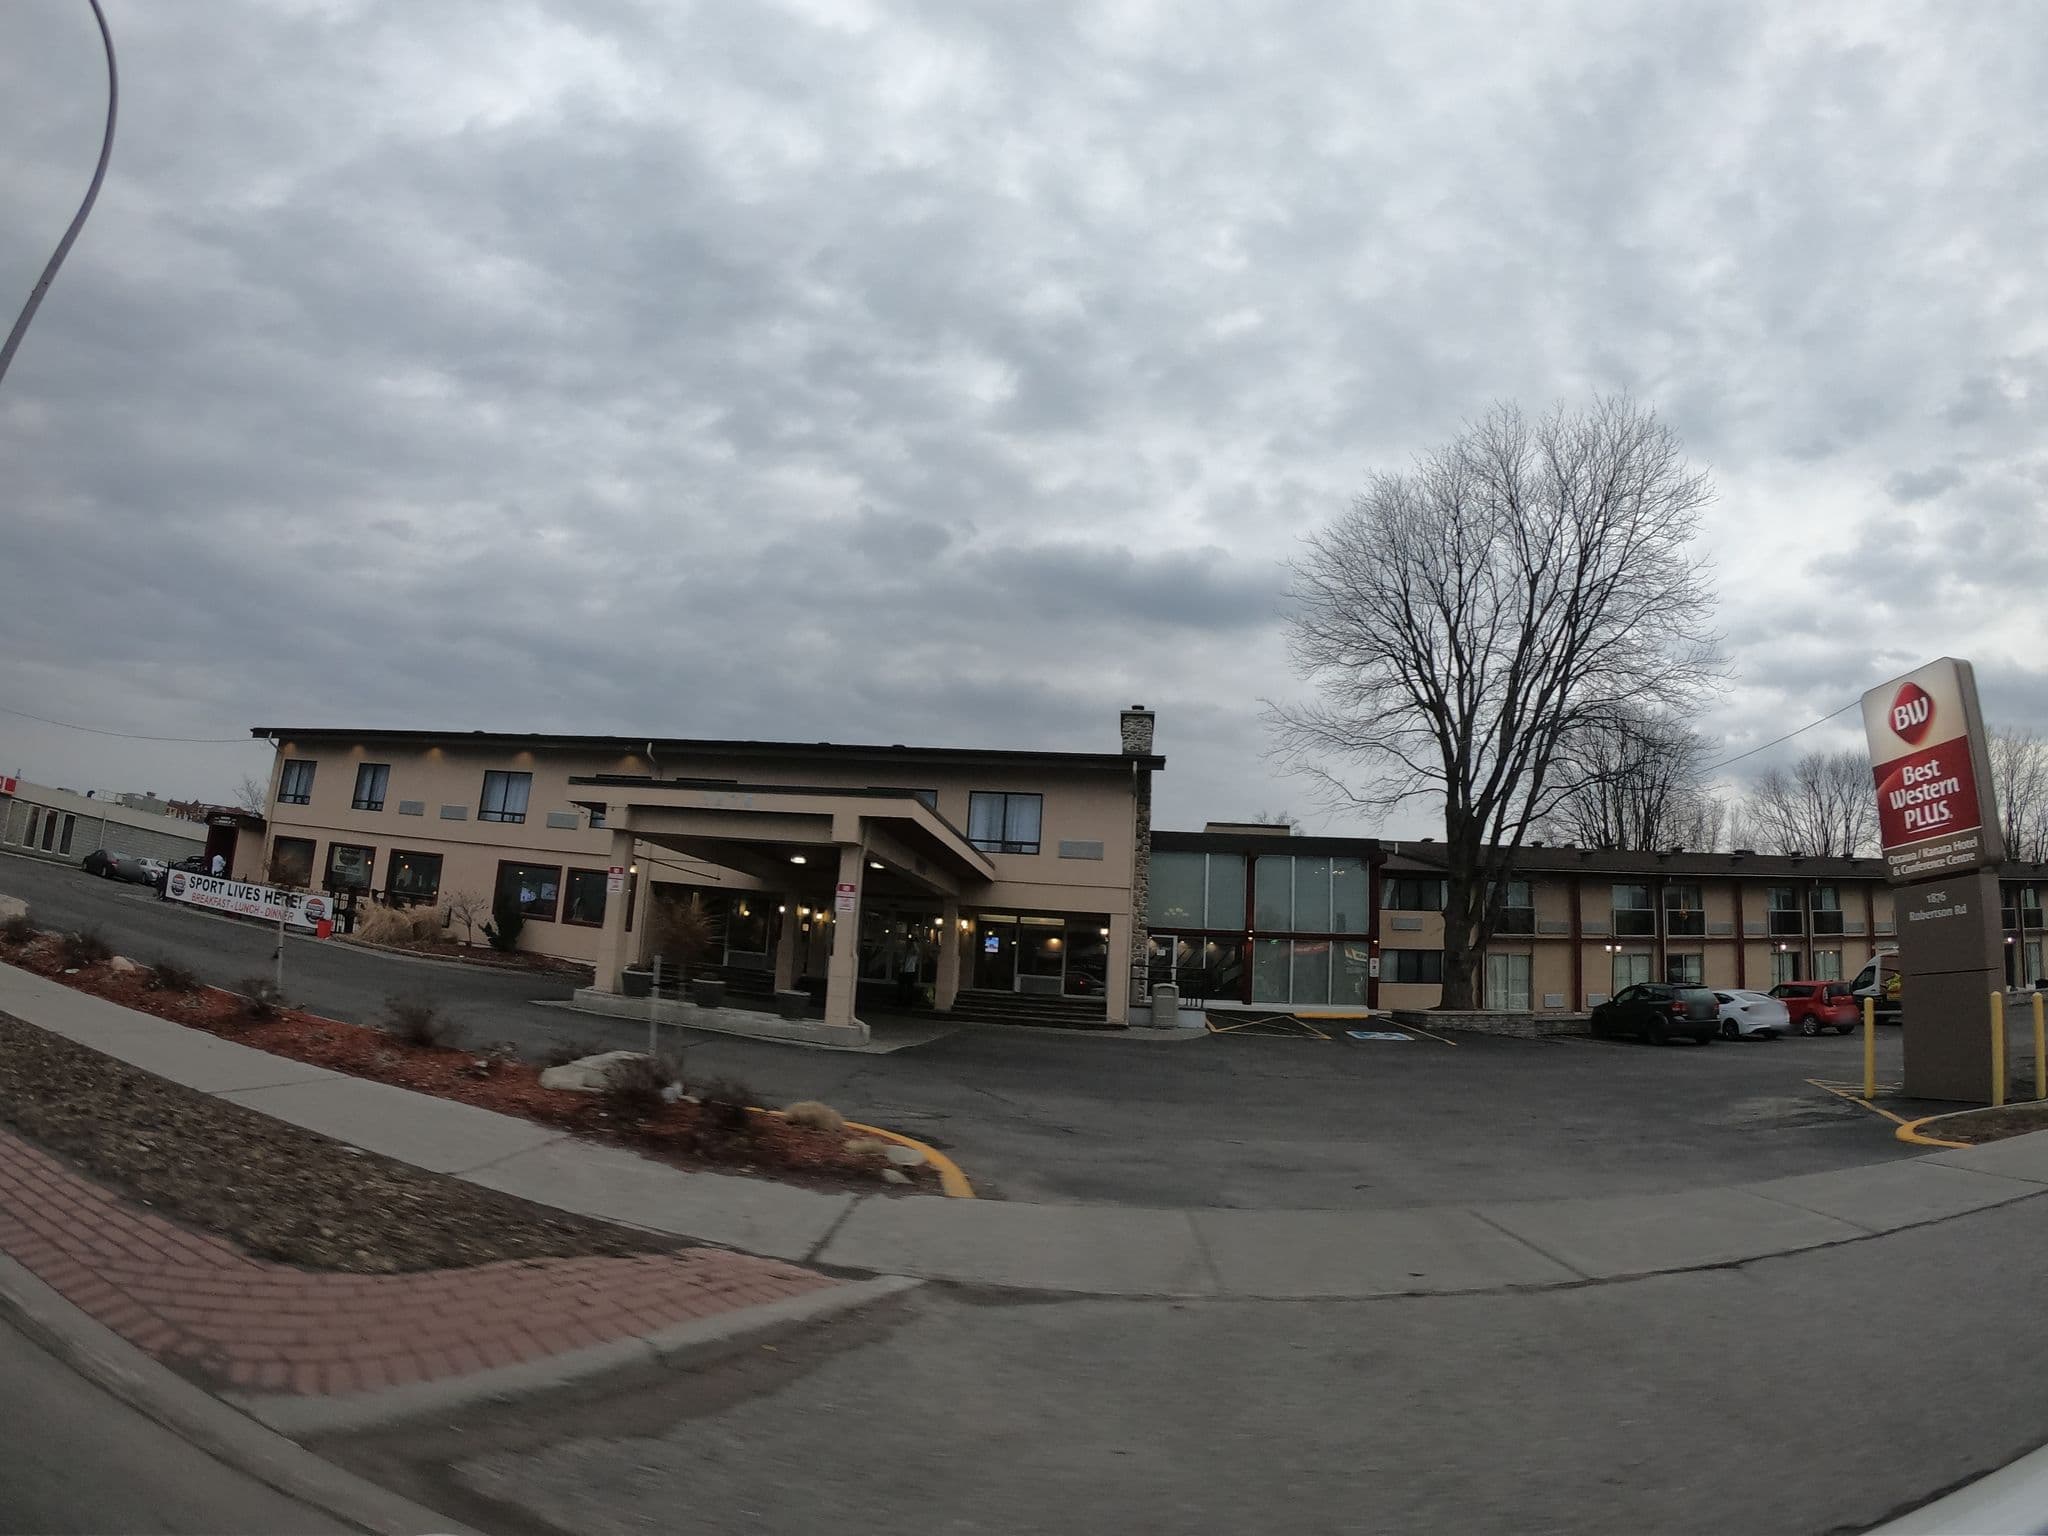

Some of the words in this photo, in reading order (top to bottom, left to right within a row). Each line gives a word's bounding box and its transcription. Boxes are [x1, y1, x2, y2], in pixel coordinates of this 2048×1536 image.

[1894, 696, 1928, 731] BW
[1902, 759, 1941, 786] Best
[1889, 777, 1960, 810] Western
[1904, 800, 1950, 830] PLUS
[1952, 836, 1978, 851] Hotel
[1900, 858, 1946, 874] Conference
[1946, 852, 1976, 865] Centre
[189, 876, 225, 894] SPORT
[227, 883, 260, 901] LIVES
[191, 892, 231, 908] BREAKFAST
[234, 901, 260, 915] LUNCH
[264, 907, 294, 922] DINNER
[1954, 903, 1967, 915] Rd
